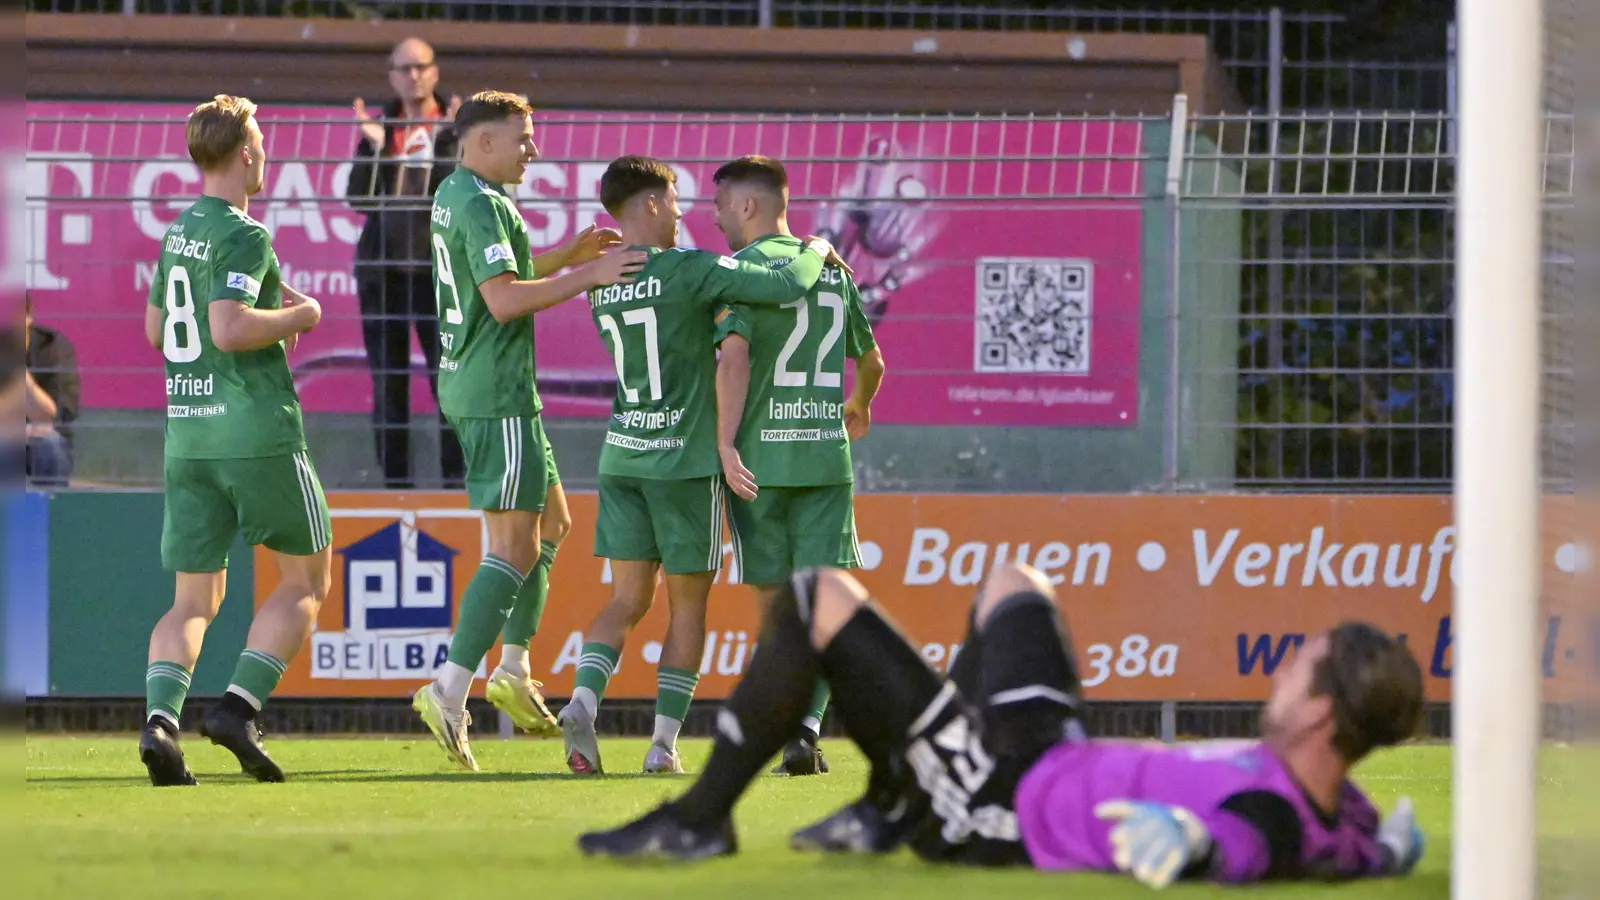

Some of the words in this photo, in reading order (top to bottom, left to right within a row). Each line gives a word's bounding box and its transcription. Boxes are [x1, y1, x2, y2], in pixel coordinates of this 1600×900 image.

[163, 265, 202, 363] 8
[773, 291, 845, 388] 22
[165, 373, 214, 396] efried
[190, 404, 226, 417] HEINEN
[648, 438, 684, 449] HEINEN
[762, 430, 819, 440] TORTECHNIK
[1192, 525, 1458, 604] Verkauf
[317, 642, 451, 671] BEILBA
[1081, 634, 1180, 688] 38a
